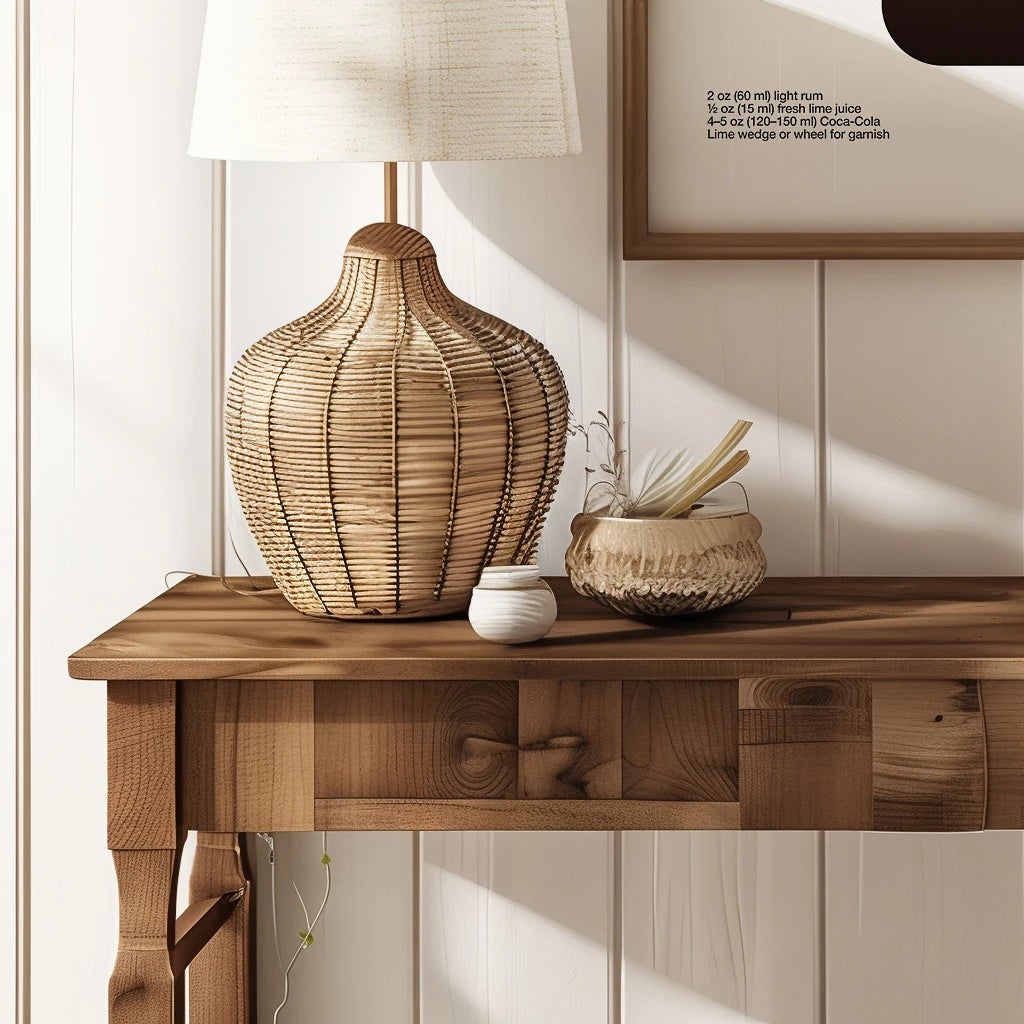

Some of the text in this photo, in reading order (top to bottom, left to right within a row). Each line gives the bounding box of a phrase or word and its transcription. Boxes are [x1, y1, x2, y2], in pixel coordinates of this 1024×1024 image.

[707, 90, 823, 103] 2 oz (60 ml) light rum
[720, 105, 735, 114] oz
[737, 103, 754, 116] (15
[757, 103, 774, 116] ml)
[777, 103, 806, 114] fresh
[808, 103, 832, 114] lime
[834, 103, 862, 116] juice
[730, 118, 744, 126] oz
[800, 116, 817, 129] ml)
[820, 116, 881, 126] Coca-Cola
[707, 128, 890, 142] Lime wedge or wheel for garnish
